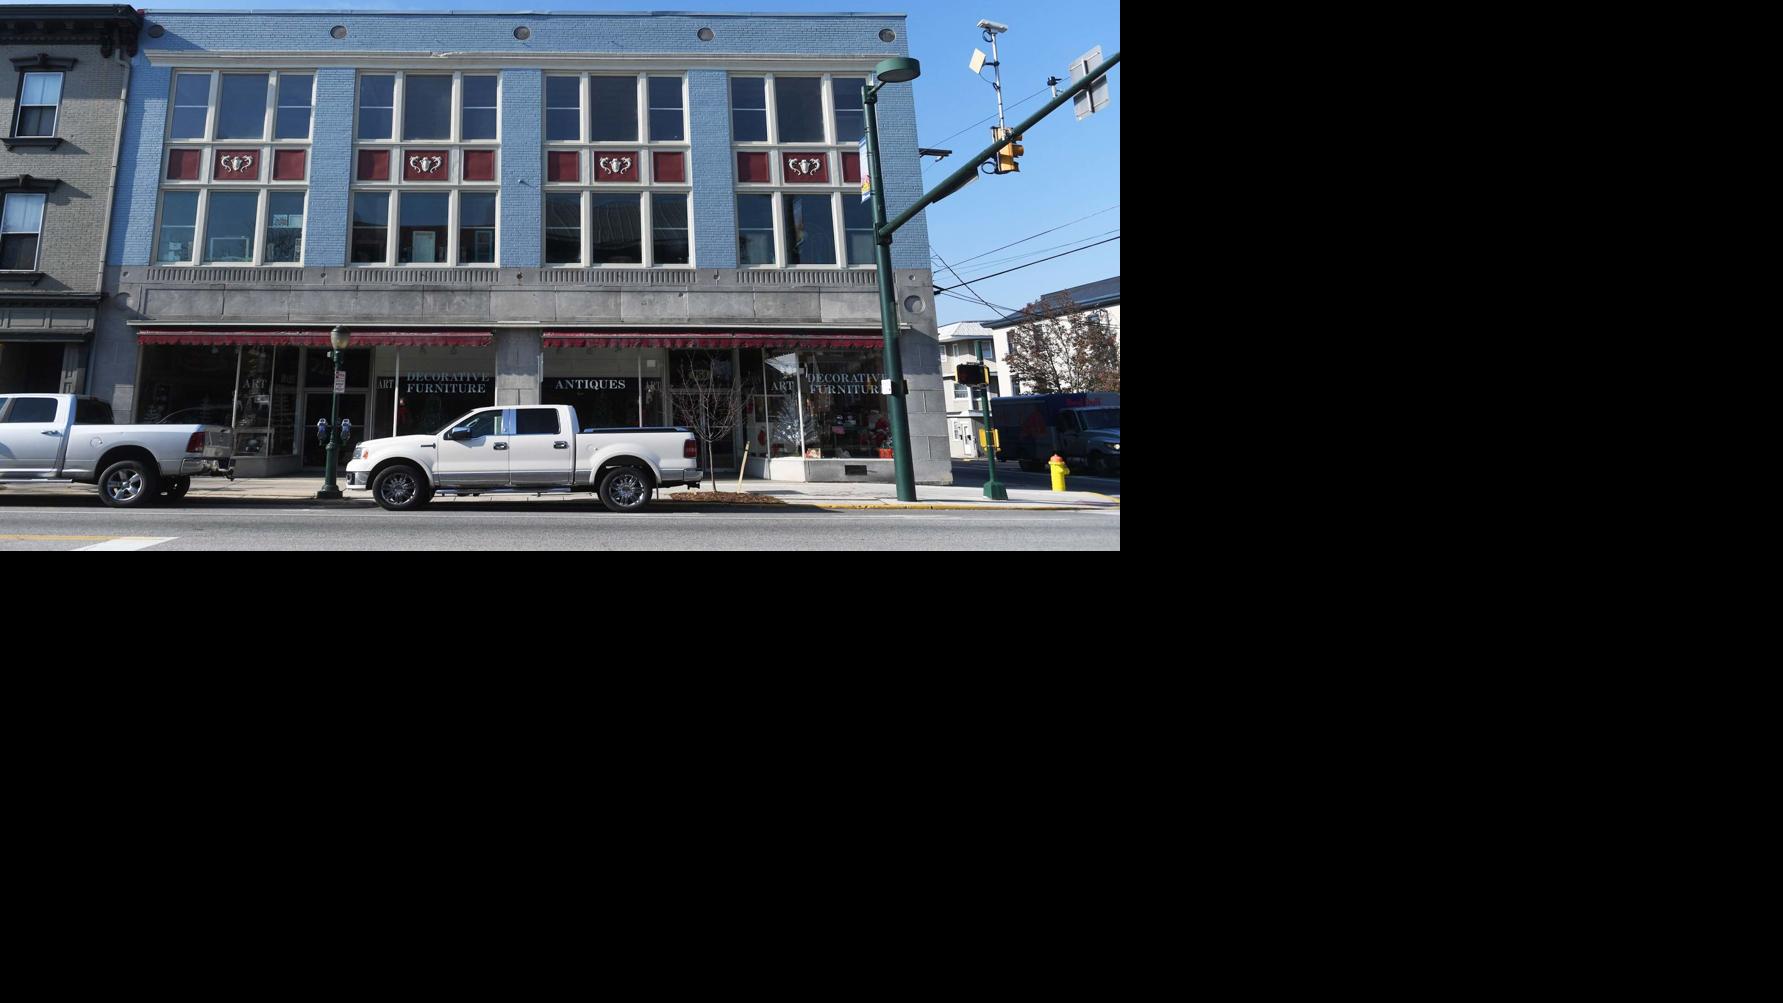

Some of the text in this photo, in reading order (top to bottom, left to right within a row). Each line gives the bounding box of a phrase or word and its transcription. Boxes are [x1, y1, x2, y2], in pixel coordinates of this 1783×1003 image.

[407, 372, 489, 382] DECORATIVE
[242, 379, 267, 389] ART
[377, 379, 394, 389] ART
[406, 383, 486, 393] FURNITURE
[555, 380, 626, 390] ANTIQUES
[771, 381, 794, 391] ART
[810, 384, 882, 394] FURNITUR
